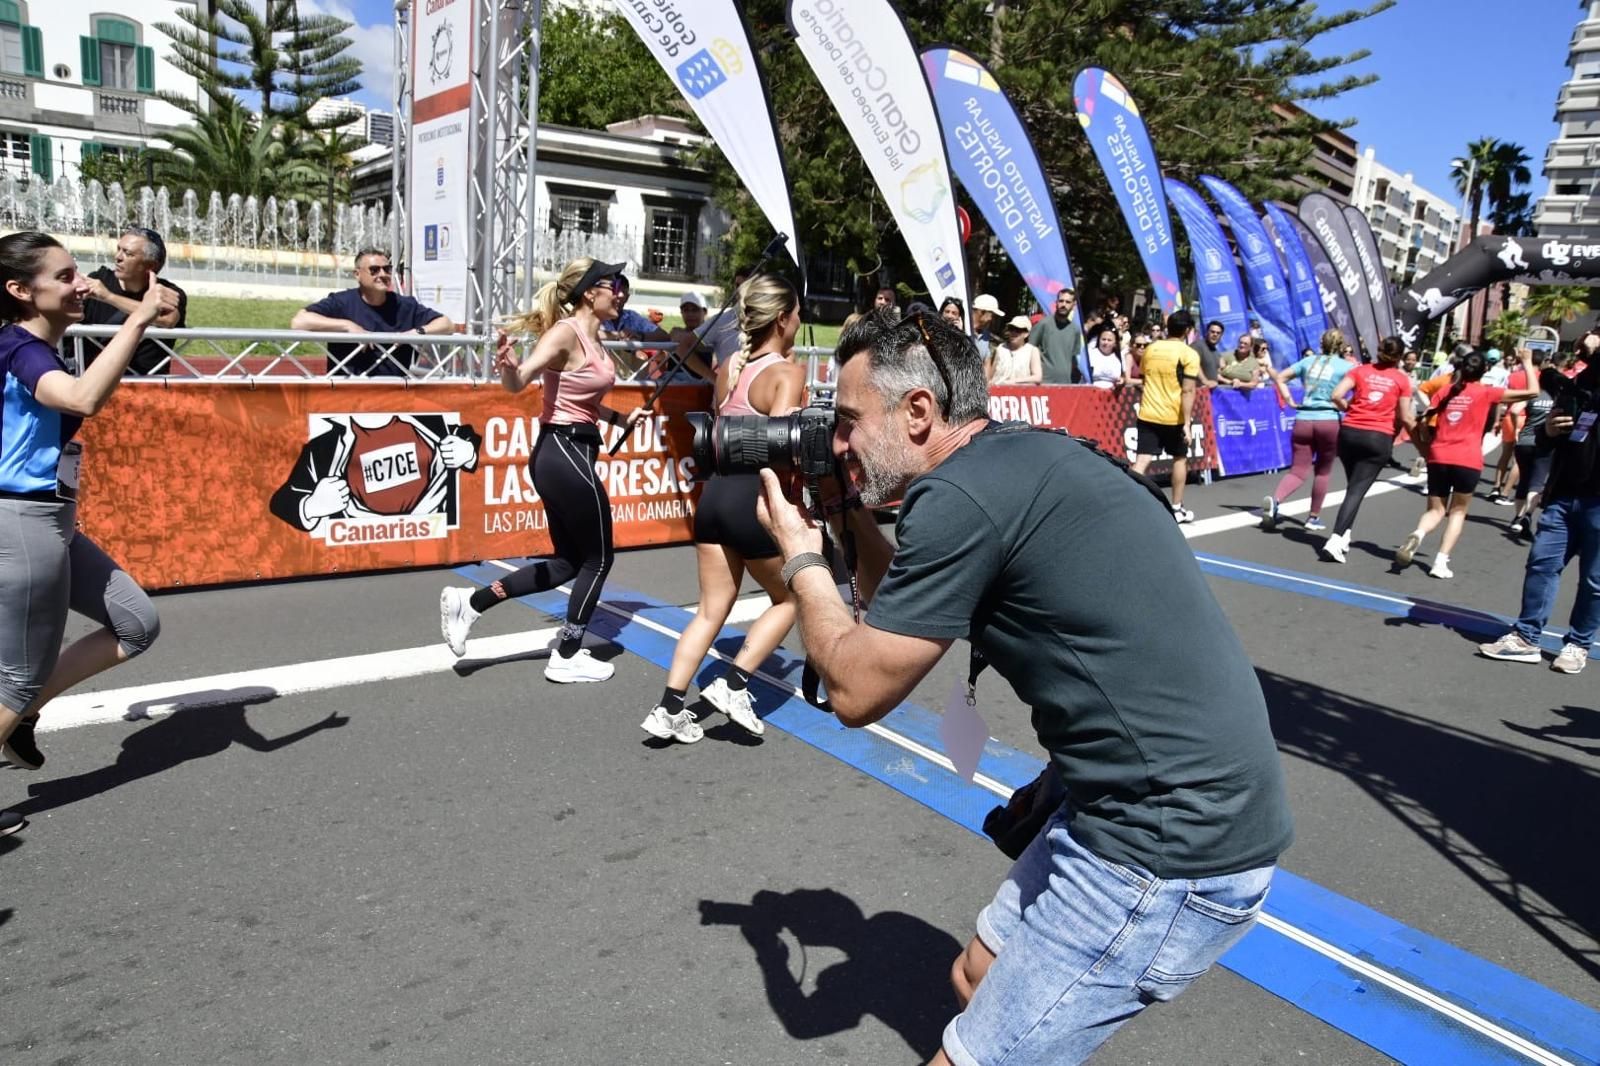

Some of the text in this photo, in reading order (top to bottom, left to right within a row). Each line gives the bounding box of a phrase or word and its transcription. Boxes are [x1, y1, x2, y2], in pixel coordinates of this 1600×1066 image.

[1030, 395, 1052, 426] DE
[633, 414, 670, 453] DE
[364, 451, 418, 482] #C7CE
[484, 511, 513, 535] LAS
[637, 499, 695, 521] CANARIA
